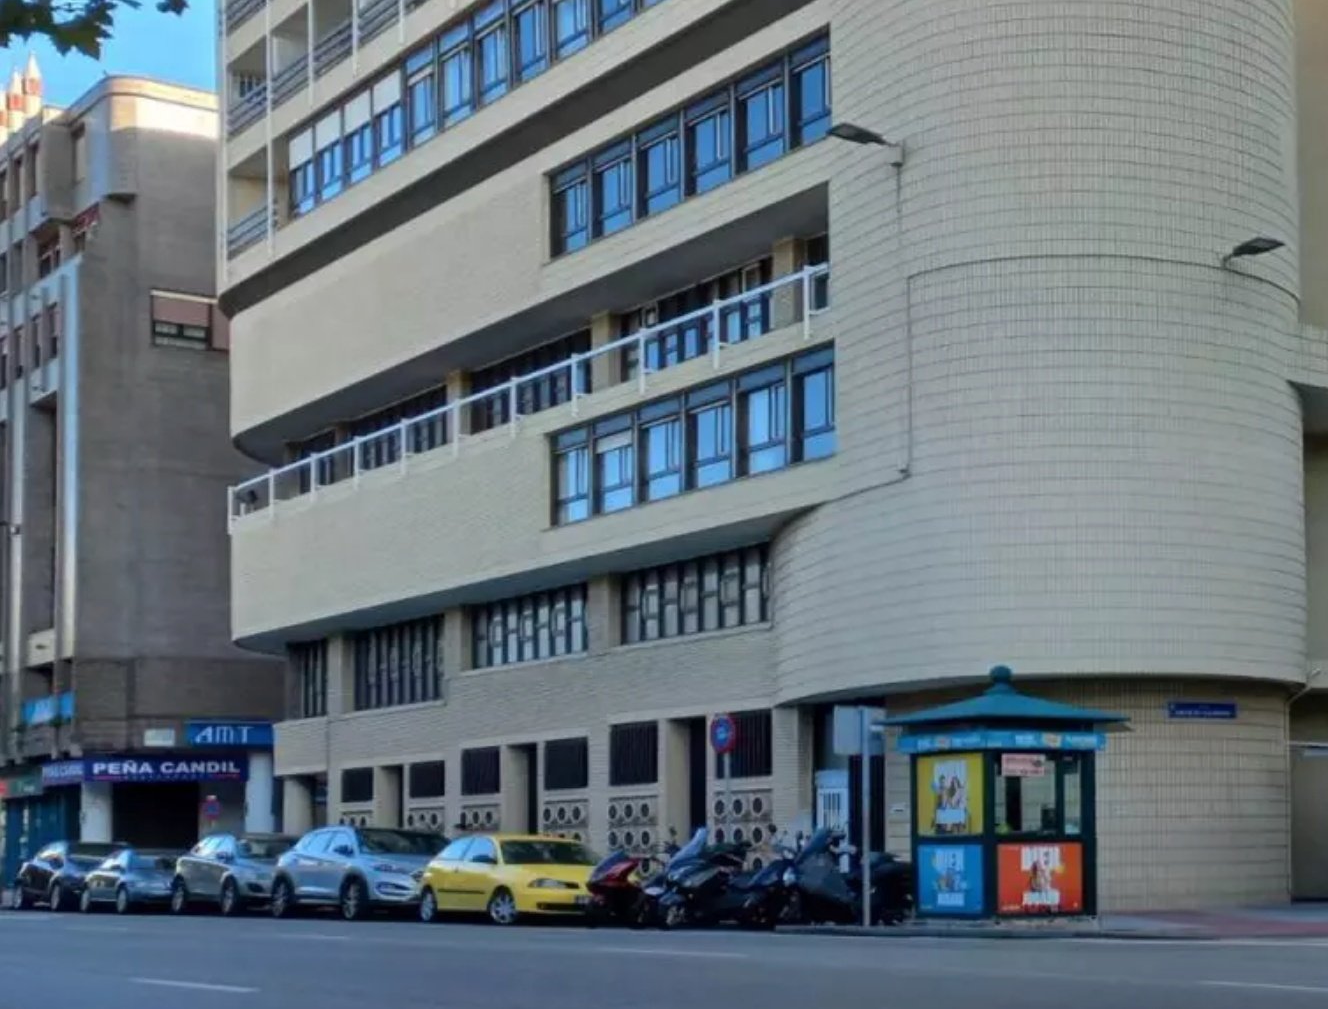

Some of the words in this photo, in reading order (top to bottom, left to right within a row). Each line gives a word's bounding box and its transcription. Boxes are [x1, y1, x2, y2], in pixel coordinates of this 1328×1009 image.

[194, 725, 254, 744] AMT
[92, 759, 153, 776] PEÑA
[160, 760, 241, 775] CANDIL
